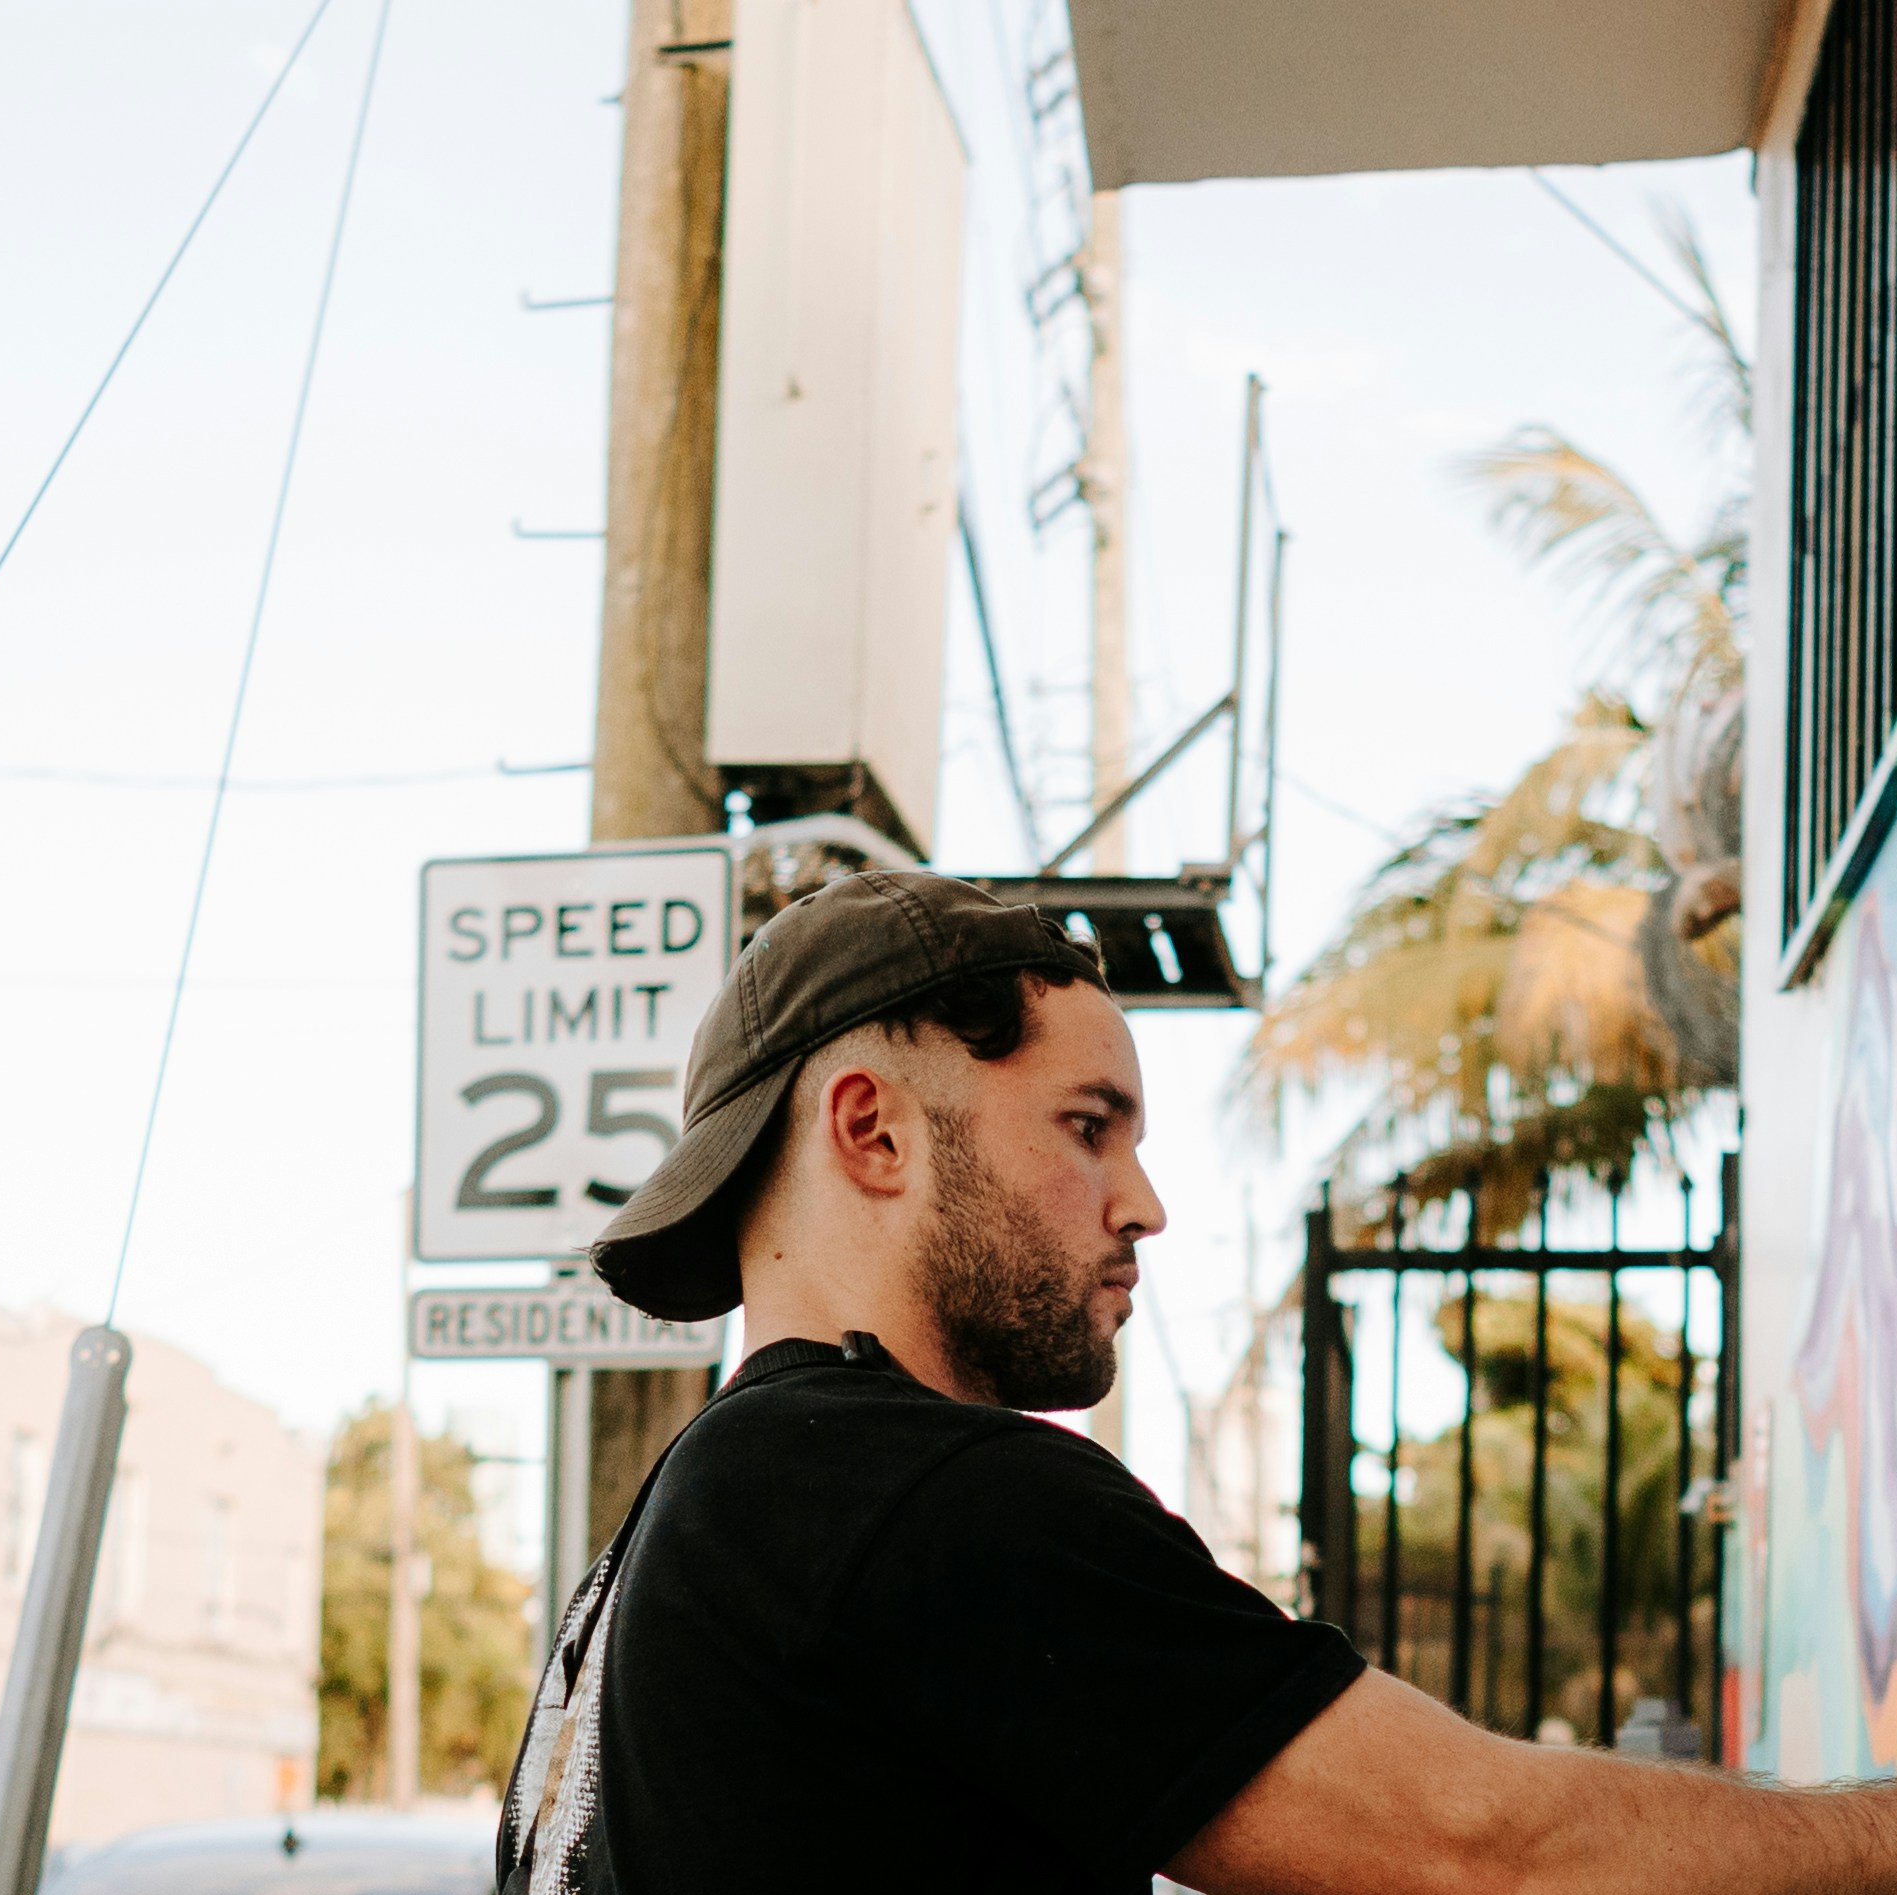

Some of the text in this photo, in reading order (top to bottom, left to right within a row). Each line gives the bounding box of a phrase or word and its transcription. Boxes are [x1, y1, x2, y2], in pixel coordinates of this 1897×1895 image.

[448, 899, 704, 963] SPEED
[473, 983, 672, 1046] LIMIT
[454, 1068, 682, 1210] 25
